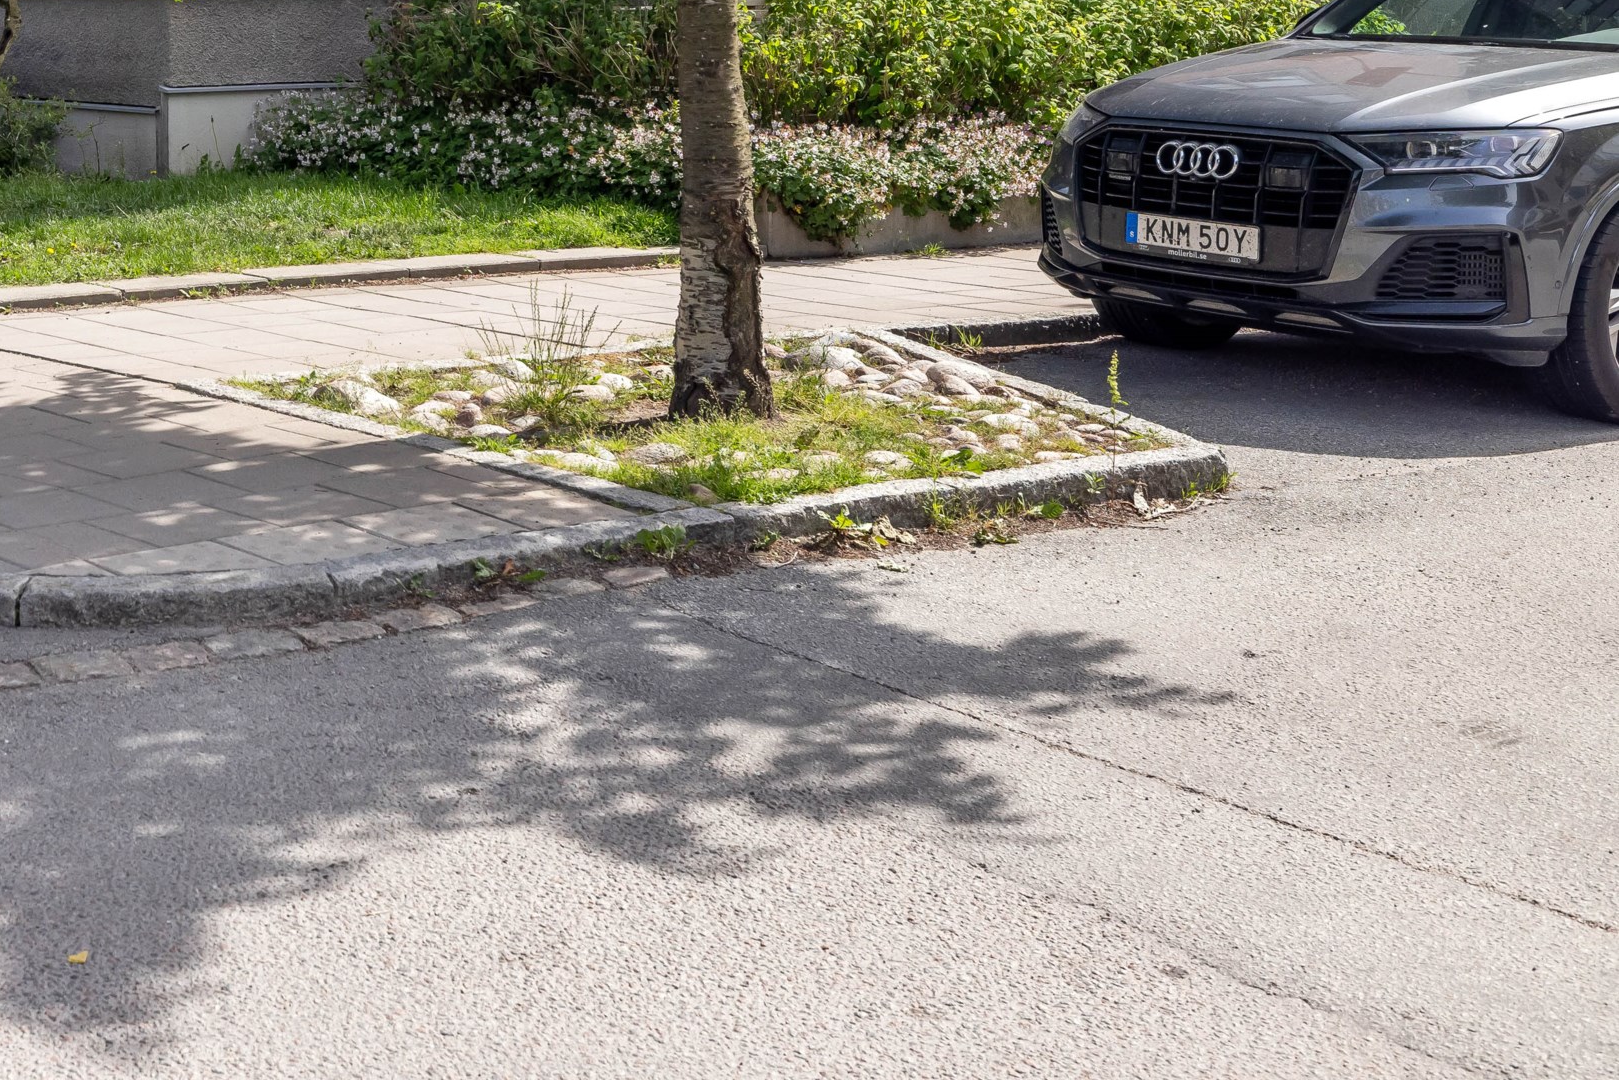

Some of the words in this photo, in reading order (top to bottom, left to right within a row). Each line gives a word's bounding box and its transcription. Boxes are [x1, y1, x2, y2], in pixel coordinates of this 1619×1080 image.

[1129, 230, 1135, 238] S
[1145, 217, 1191, 248] KNM
[1198, 224, 1248, 254] 50Y
[1167, 249, 1208, 260] mollerbil.se
